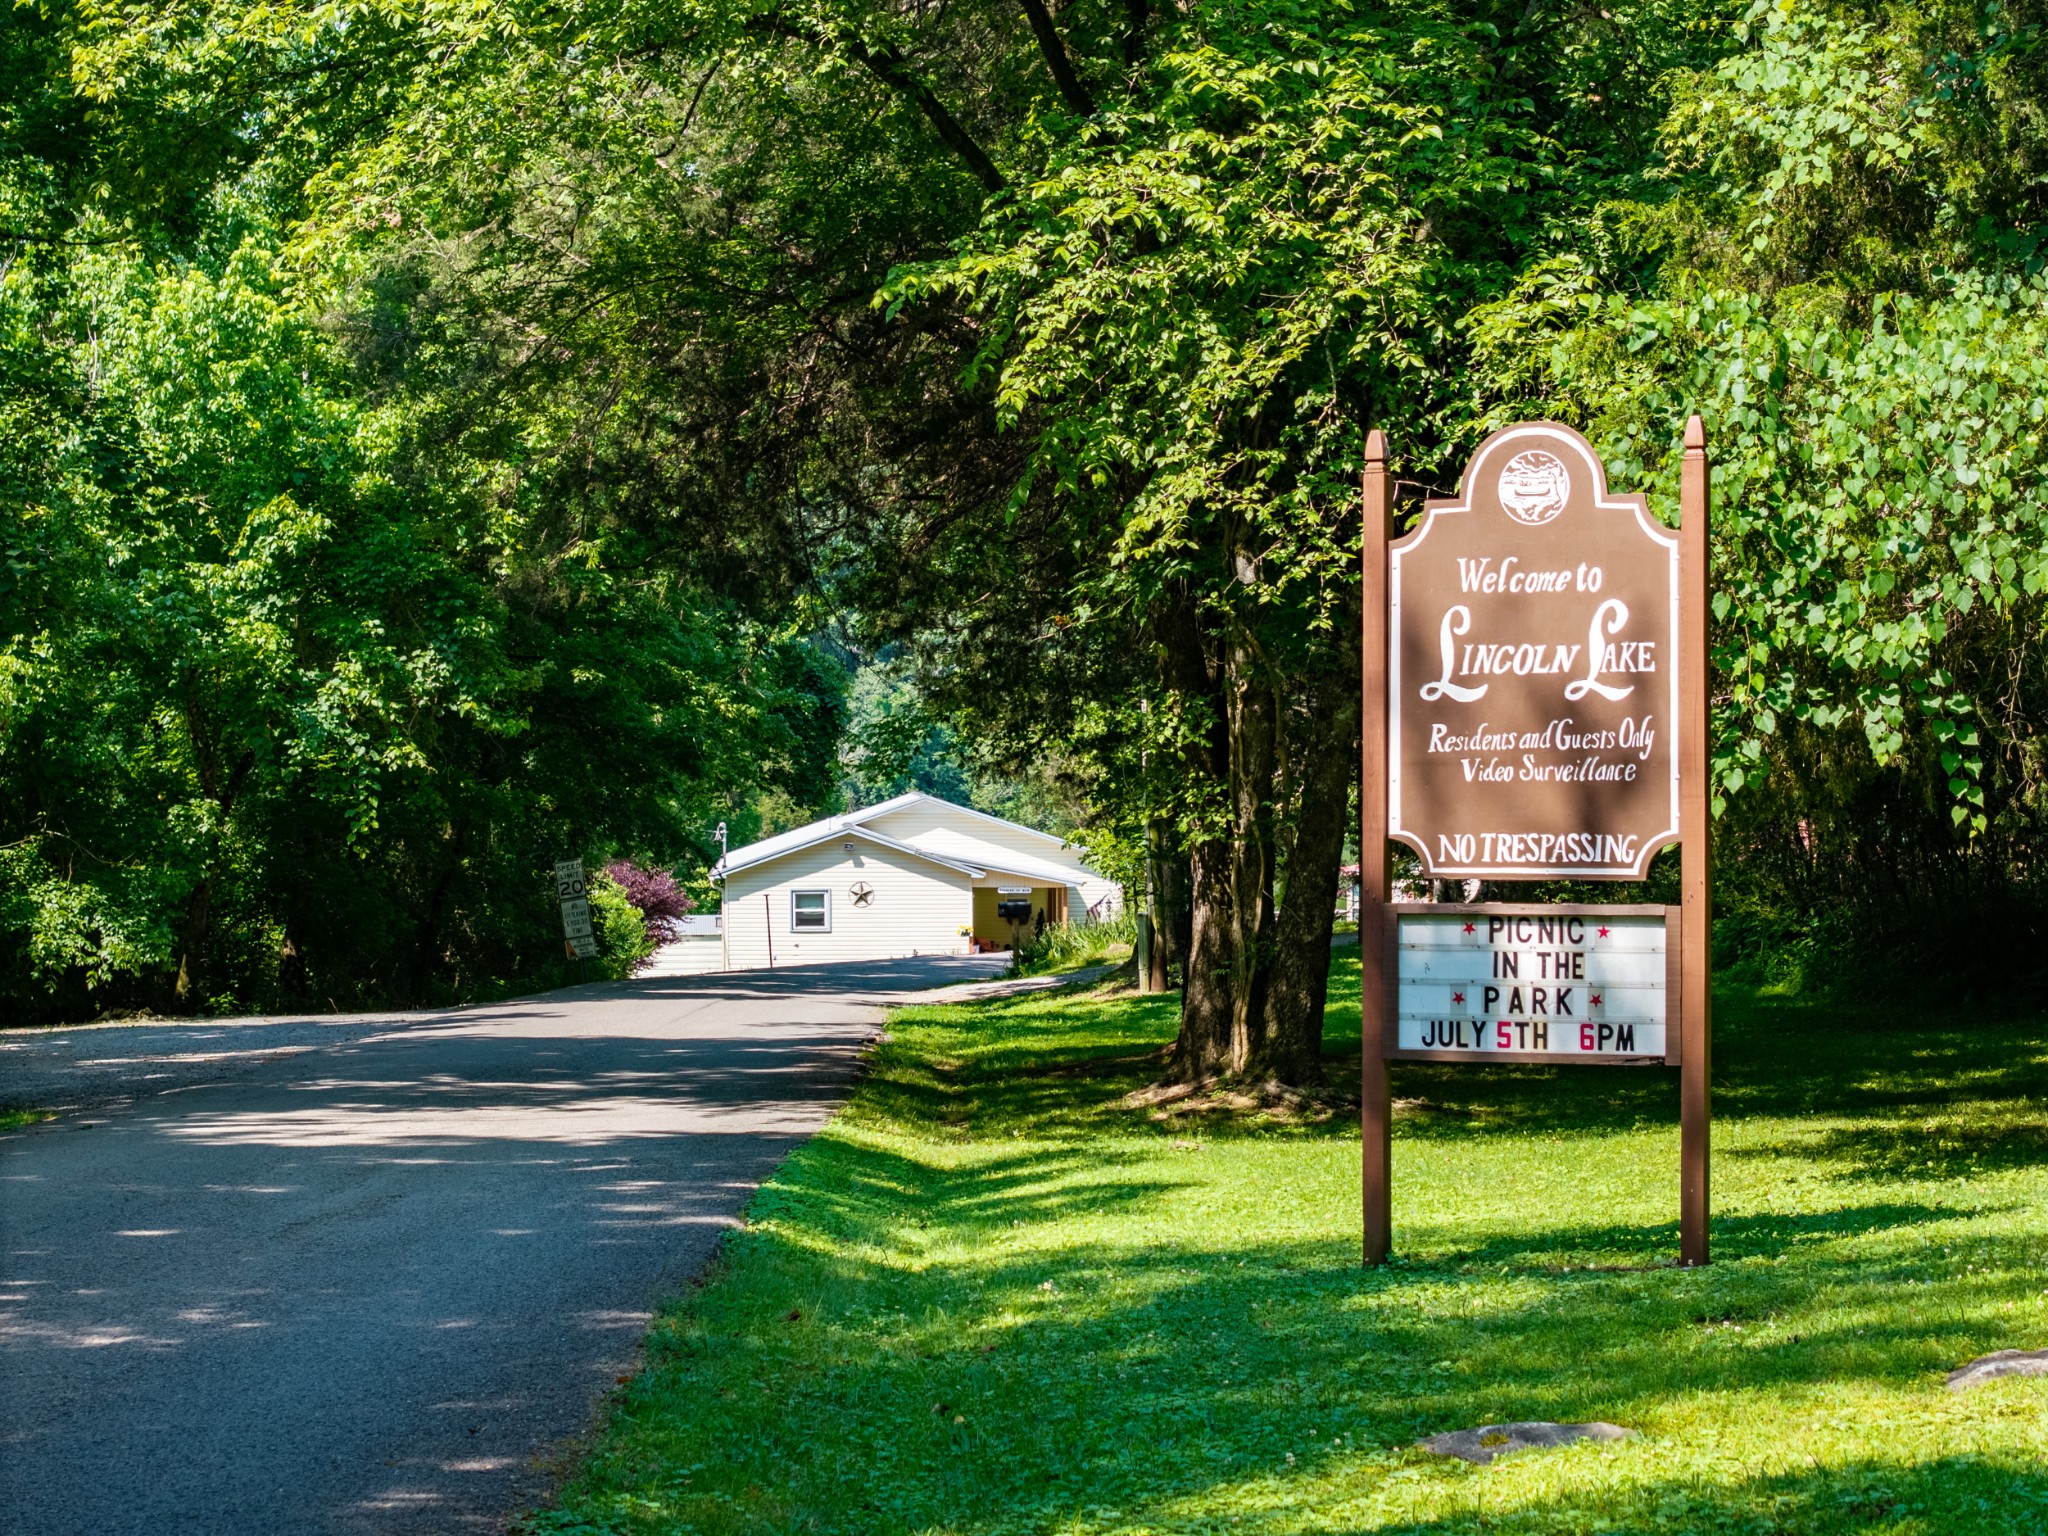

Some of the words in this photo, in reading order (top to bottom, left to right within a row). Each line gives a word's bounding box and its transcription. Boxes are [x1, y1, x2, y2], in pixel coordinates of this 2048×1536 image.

[1456, 556, 1572, 594] Welcome
[1576, 562, 1602, 592] to
[1564, 599, 1656, 701] LAKE
[1428, 723, 1517, 753] Residents
[1519, 719, 1558, 750] and
[1555, 718, 1615, 750] Guests
[1619, 715, 1655, 760] Only
[1461, 757, 1514, 782] Video
[1519, 754, 1636, 782] Surveillance
[1438, 833, 1476, 863] NO
[1480, 832, 1637, 864] TRESPASSING
[557, 863, 580, 873] SPEED
[560, 871, 579, 880] LIMIT
[559, 880, 583, 896] 20
[1488, 916, 1584, 945] PICNIC
[1493, 951, 1518, 979] IN
[1537, 952, 1584, 980] THE
[1484, 986, 1573, 1015] PARK
[1421, 1020, 1486, 1048] JULY
[1497, 1021, 1548, 1050] 5TH
[1579, 1023, 1635, 1051] 6PM
